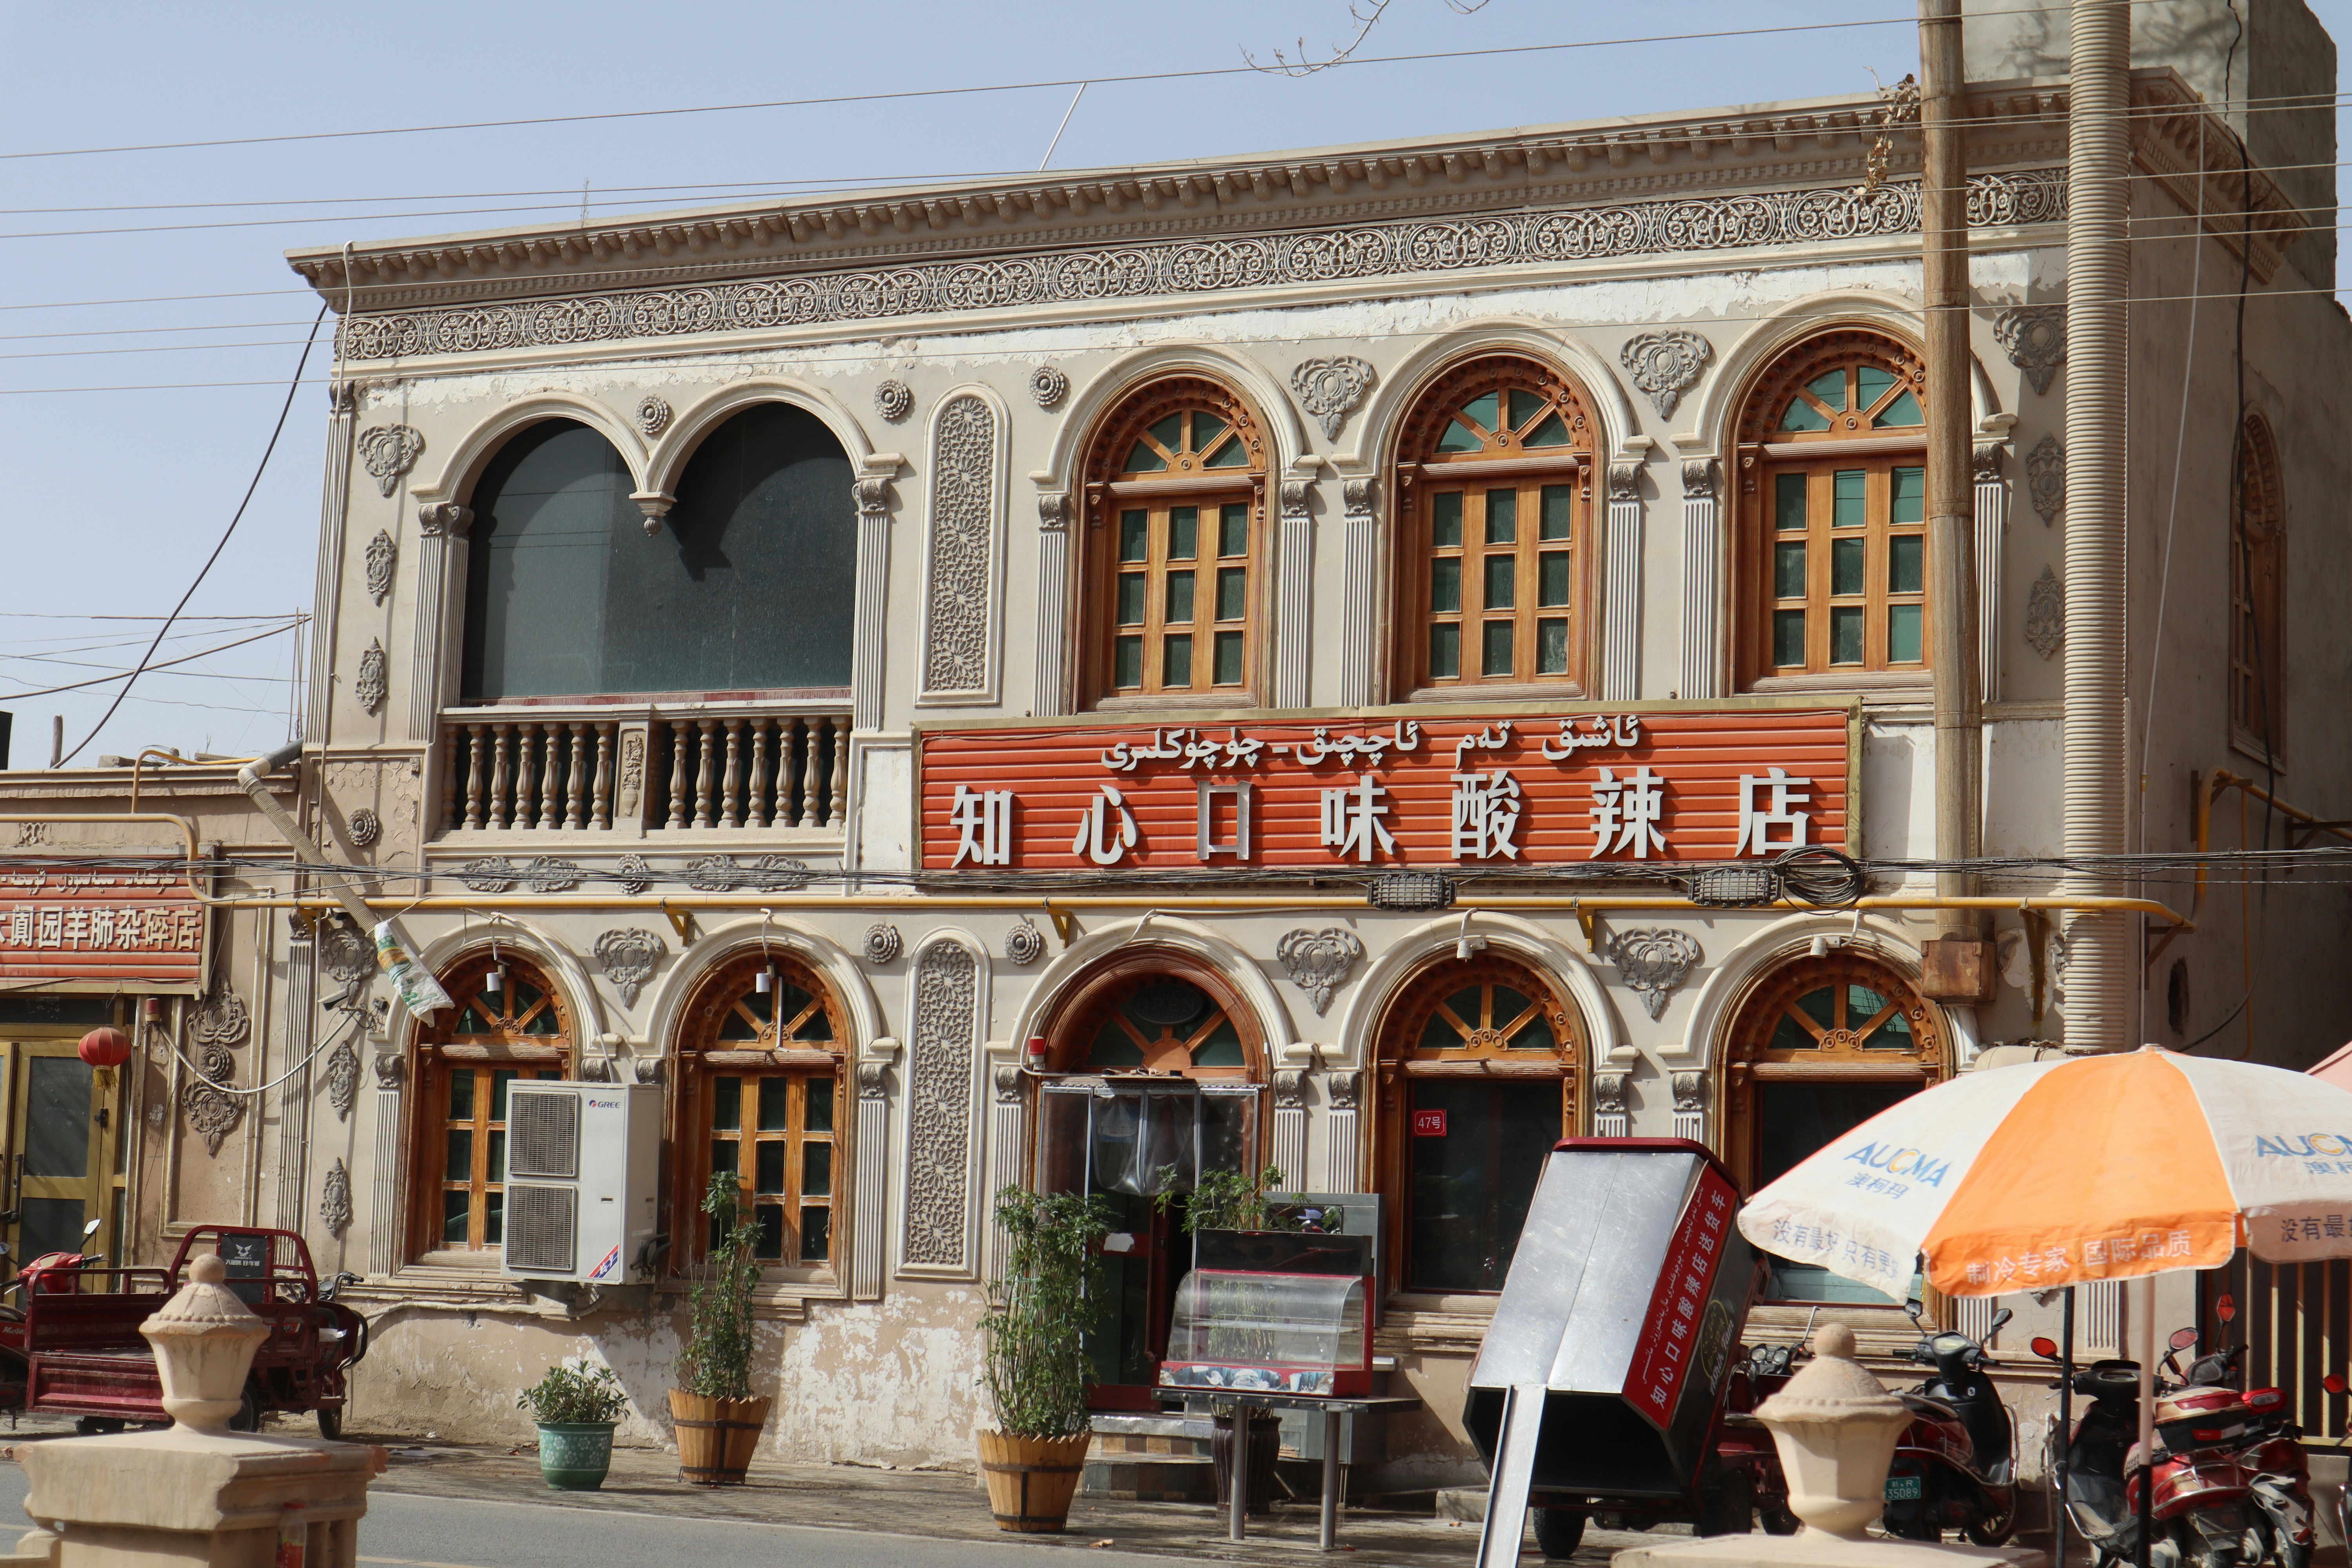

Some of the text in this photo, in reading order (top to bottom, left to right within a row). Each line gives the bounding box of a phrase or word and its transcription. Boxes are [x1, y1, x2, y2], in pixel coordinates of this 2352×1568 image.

[1455, 720, 1513, 770] تەم
[1542, 714, 1639, 760] ئاشىق
[950, 766, 1811, 869] 知心口味酸辣店
[0, 903, 196, 950] 阗园羊肺杂碎店
[1418, 1116, 1441, 1129] 47号
[1842, 1140, 1952, 1188] AUCMA
[1845, 1172, 1910, 1199] 澳柯玛
[2281, 1214, 2352, 1242] 没有最
[1966, 1229, 2192, 1286] 制冷专家 国际品质
[1650, 1190, 1726, 1410] 知心口味酸辣店送货车
[1887, 1488, 1918, 1498] 35D89
